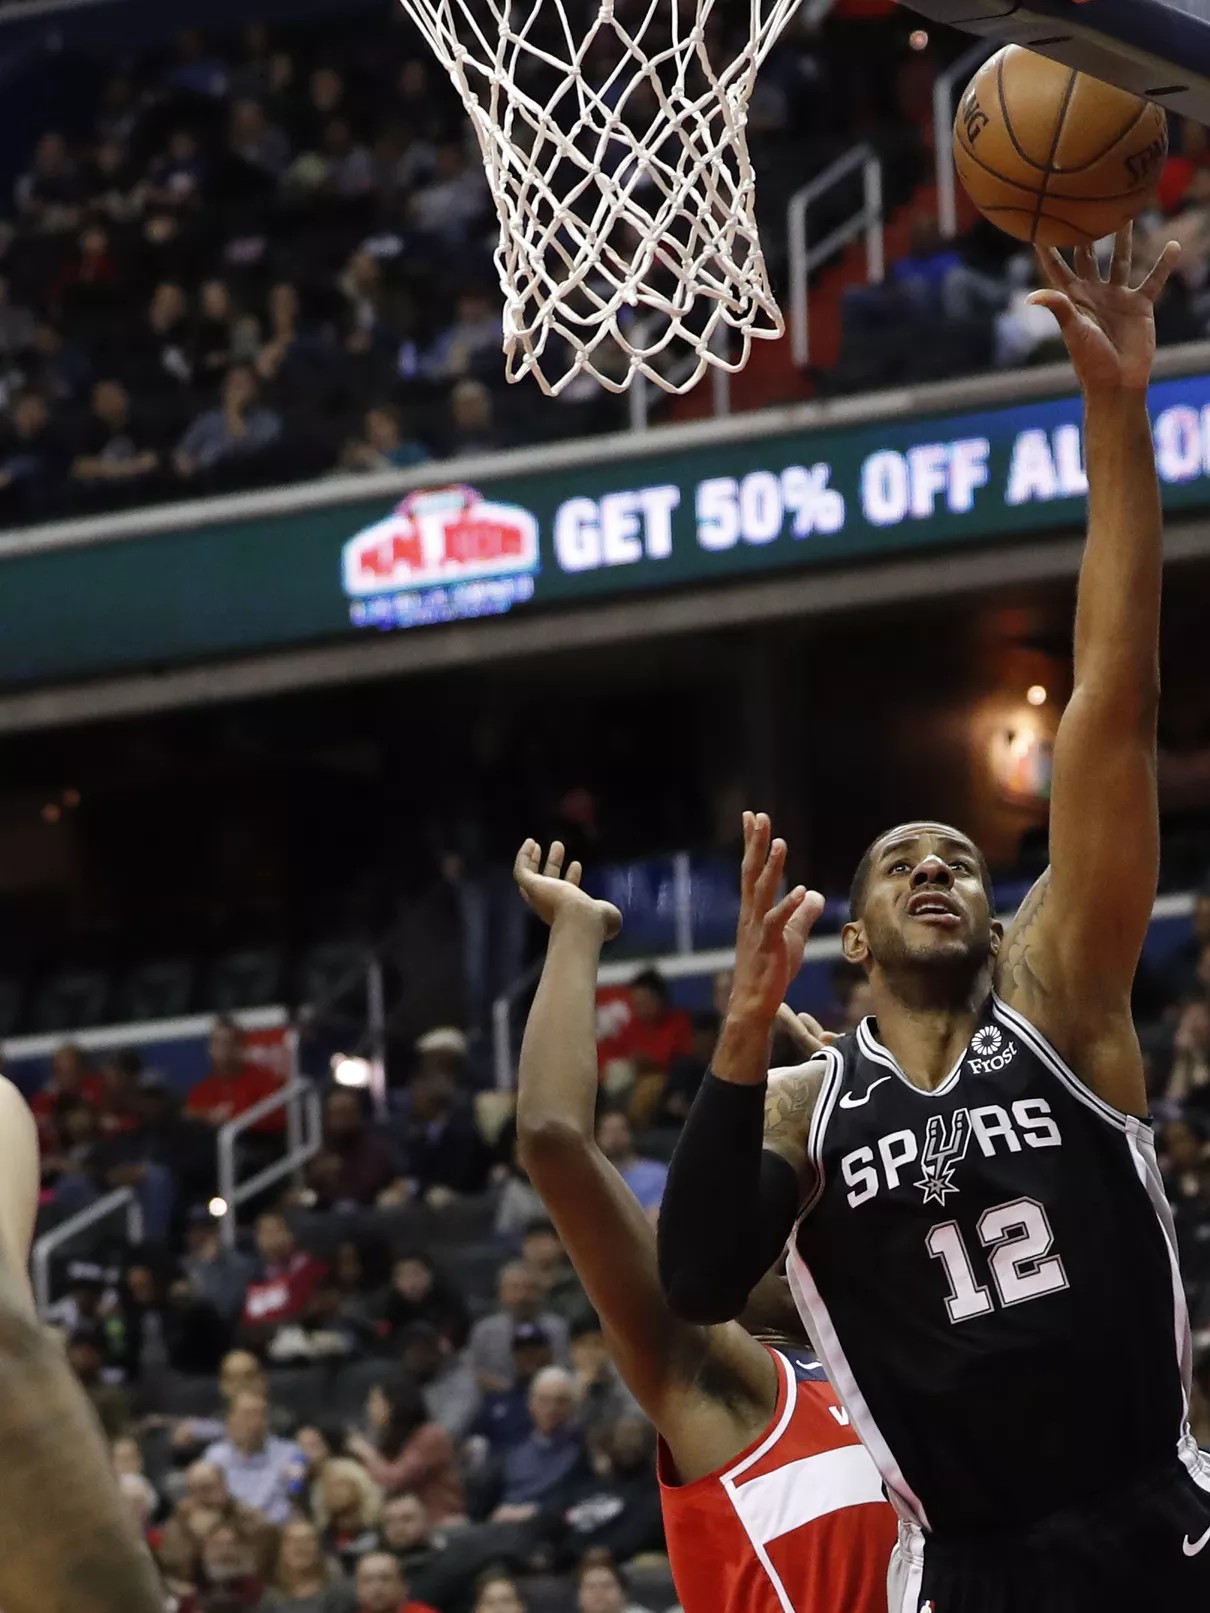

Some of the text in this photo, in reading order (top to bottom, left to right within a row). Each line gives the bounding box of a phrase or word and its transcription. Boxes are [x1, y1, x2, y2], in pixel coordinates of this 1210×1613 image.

[554, 484, 681, 572] GET
[696, 462, 845, 550] 50%
[862, 438, 990, 525] OFF
[1005, 424, 1089, 506] AL
[967, 1041, 1018, 1075] Frost
[841, 1098, 1062, 1208] SPURS
[925, 1196, 1070, 1324] 12
